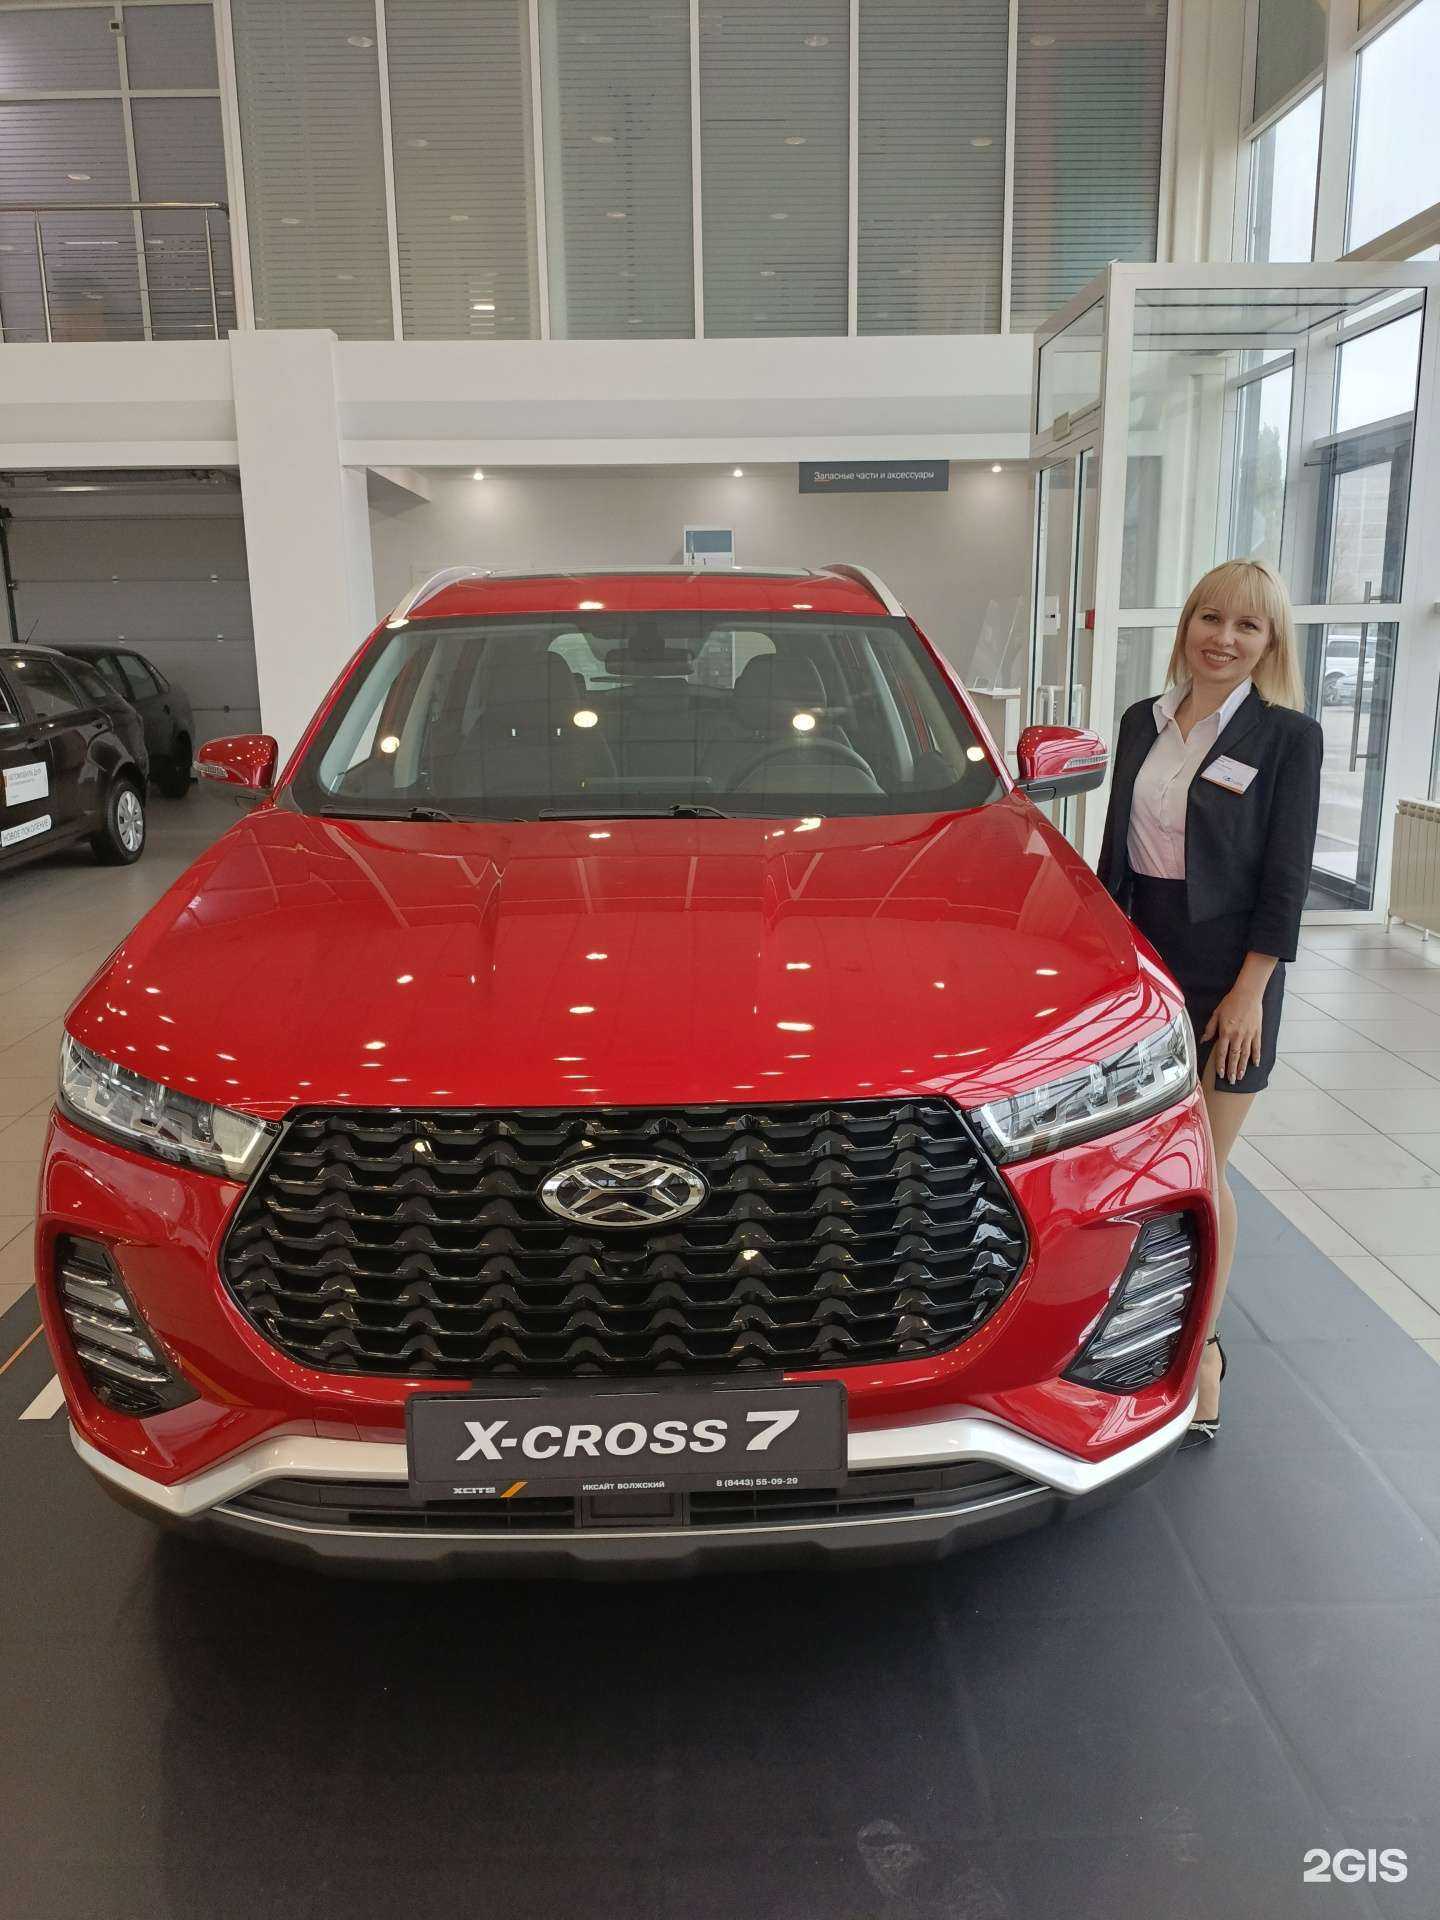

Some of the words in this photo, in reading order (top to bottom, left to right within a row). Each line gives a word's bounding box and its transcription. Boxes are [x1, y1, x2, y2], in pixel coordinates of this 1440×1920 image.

[814, 471, 854, 481] Запасные
[856, 472, 879, 480] части
[887, 471, 935, 481] аксессуары
[456, 1418, 728, 1461] X-CROSS
[745, 1409, 799, 1451] 7
[582, 1482, 615, 1491] ИКСАЙТ
[617, 1480, 665, 1490] ВОЛЖСКИЙ
[716, 1479, 723, 1487] 8
[724, 1479, 754, 1488] (8443)
